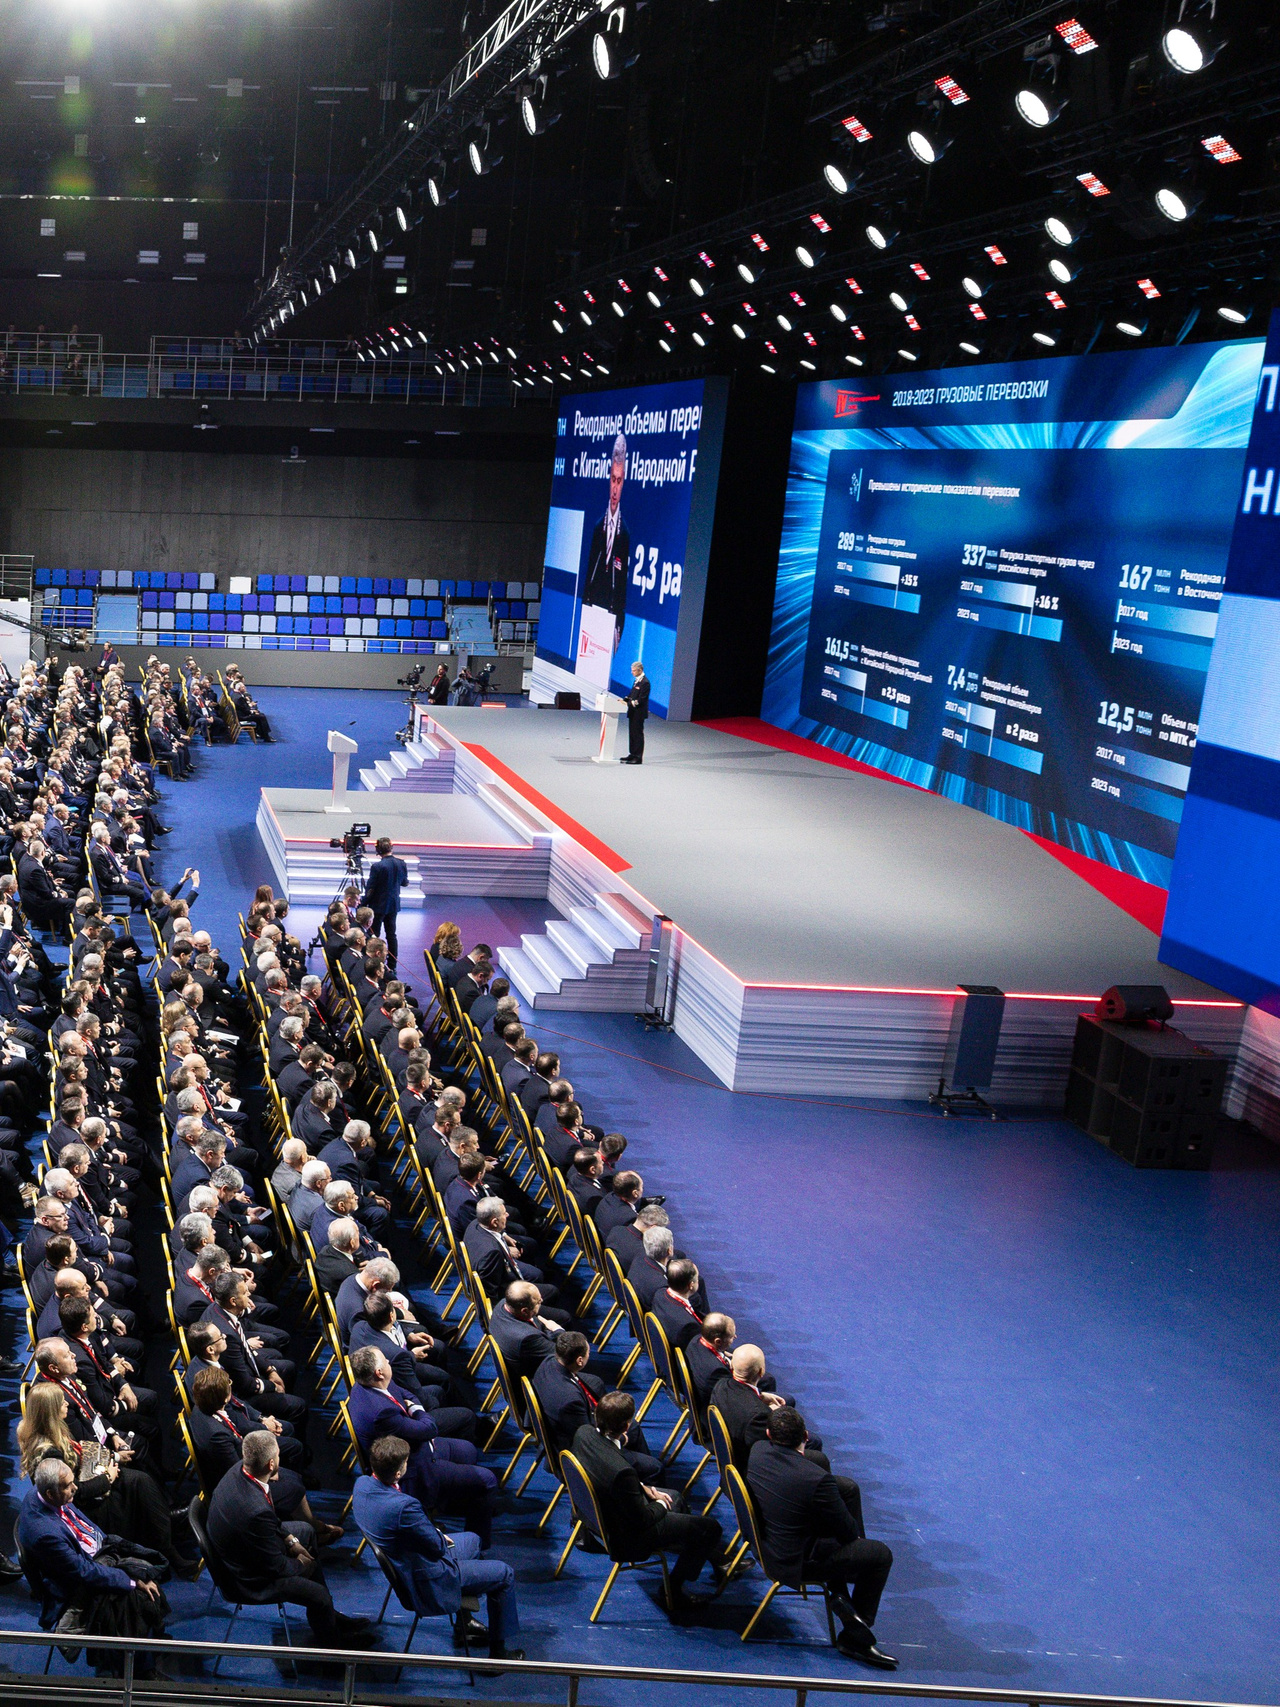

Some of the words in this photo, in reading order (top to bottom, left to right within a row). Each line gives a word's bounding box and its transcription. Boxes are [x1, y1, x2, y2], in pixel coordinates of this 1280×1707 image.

[892, 388, 935, 407] 2018-2023
[935, 385, 984, 404] ГРУЗОВЫЕ
[985, 379, 1050, 401] ПЕРЕВОЗКИ
[574, 410, 623, 443] Рекордные
[624, 404, 667, 435] объемы
[670, 405, 703, 440] пере
[630, 451, 687, 489] Народной
[837, 532, 855, 551] 289
[962, 544, 987, 566] 337
[632, 544, 659, 597] 2,3
[901, 574, 912, 586] +15
[1119, 564, 1153, 591] 167
[1180, 569, 1221, 584] Рекордная
[960, 581, 974, 591] 2017
[1034, 595, 1051, 610] +16
[957, 608, 970, 618] 2023
[1118, 605, 1136, 617] 2017
[1136, 610, 1148, 621] год
[825, 637, 850, 661] 161,5
[1113, 638, 1130, 650] 2023
[1130, 643, 1143, 654] год
[947, 664, 965, 691] 7,4
[945, 701, 958, 712] 2017
[1098, 701, 1135, 734] 12,5
[1161, 713, 1186, 729] Объем
[1012, 723, 1019, 737] 2
[1019, 729, 1039, 743] раза
[1159, 731, 1169, 740] по
[1169, 731, 1189, 746] МТК
[1096, 746, 1113, 759] 2017
[1113, 754, 1126, 766] год
[1091, 777, 1108, 792] 2023
[1108, 786, 1121, 798] год
